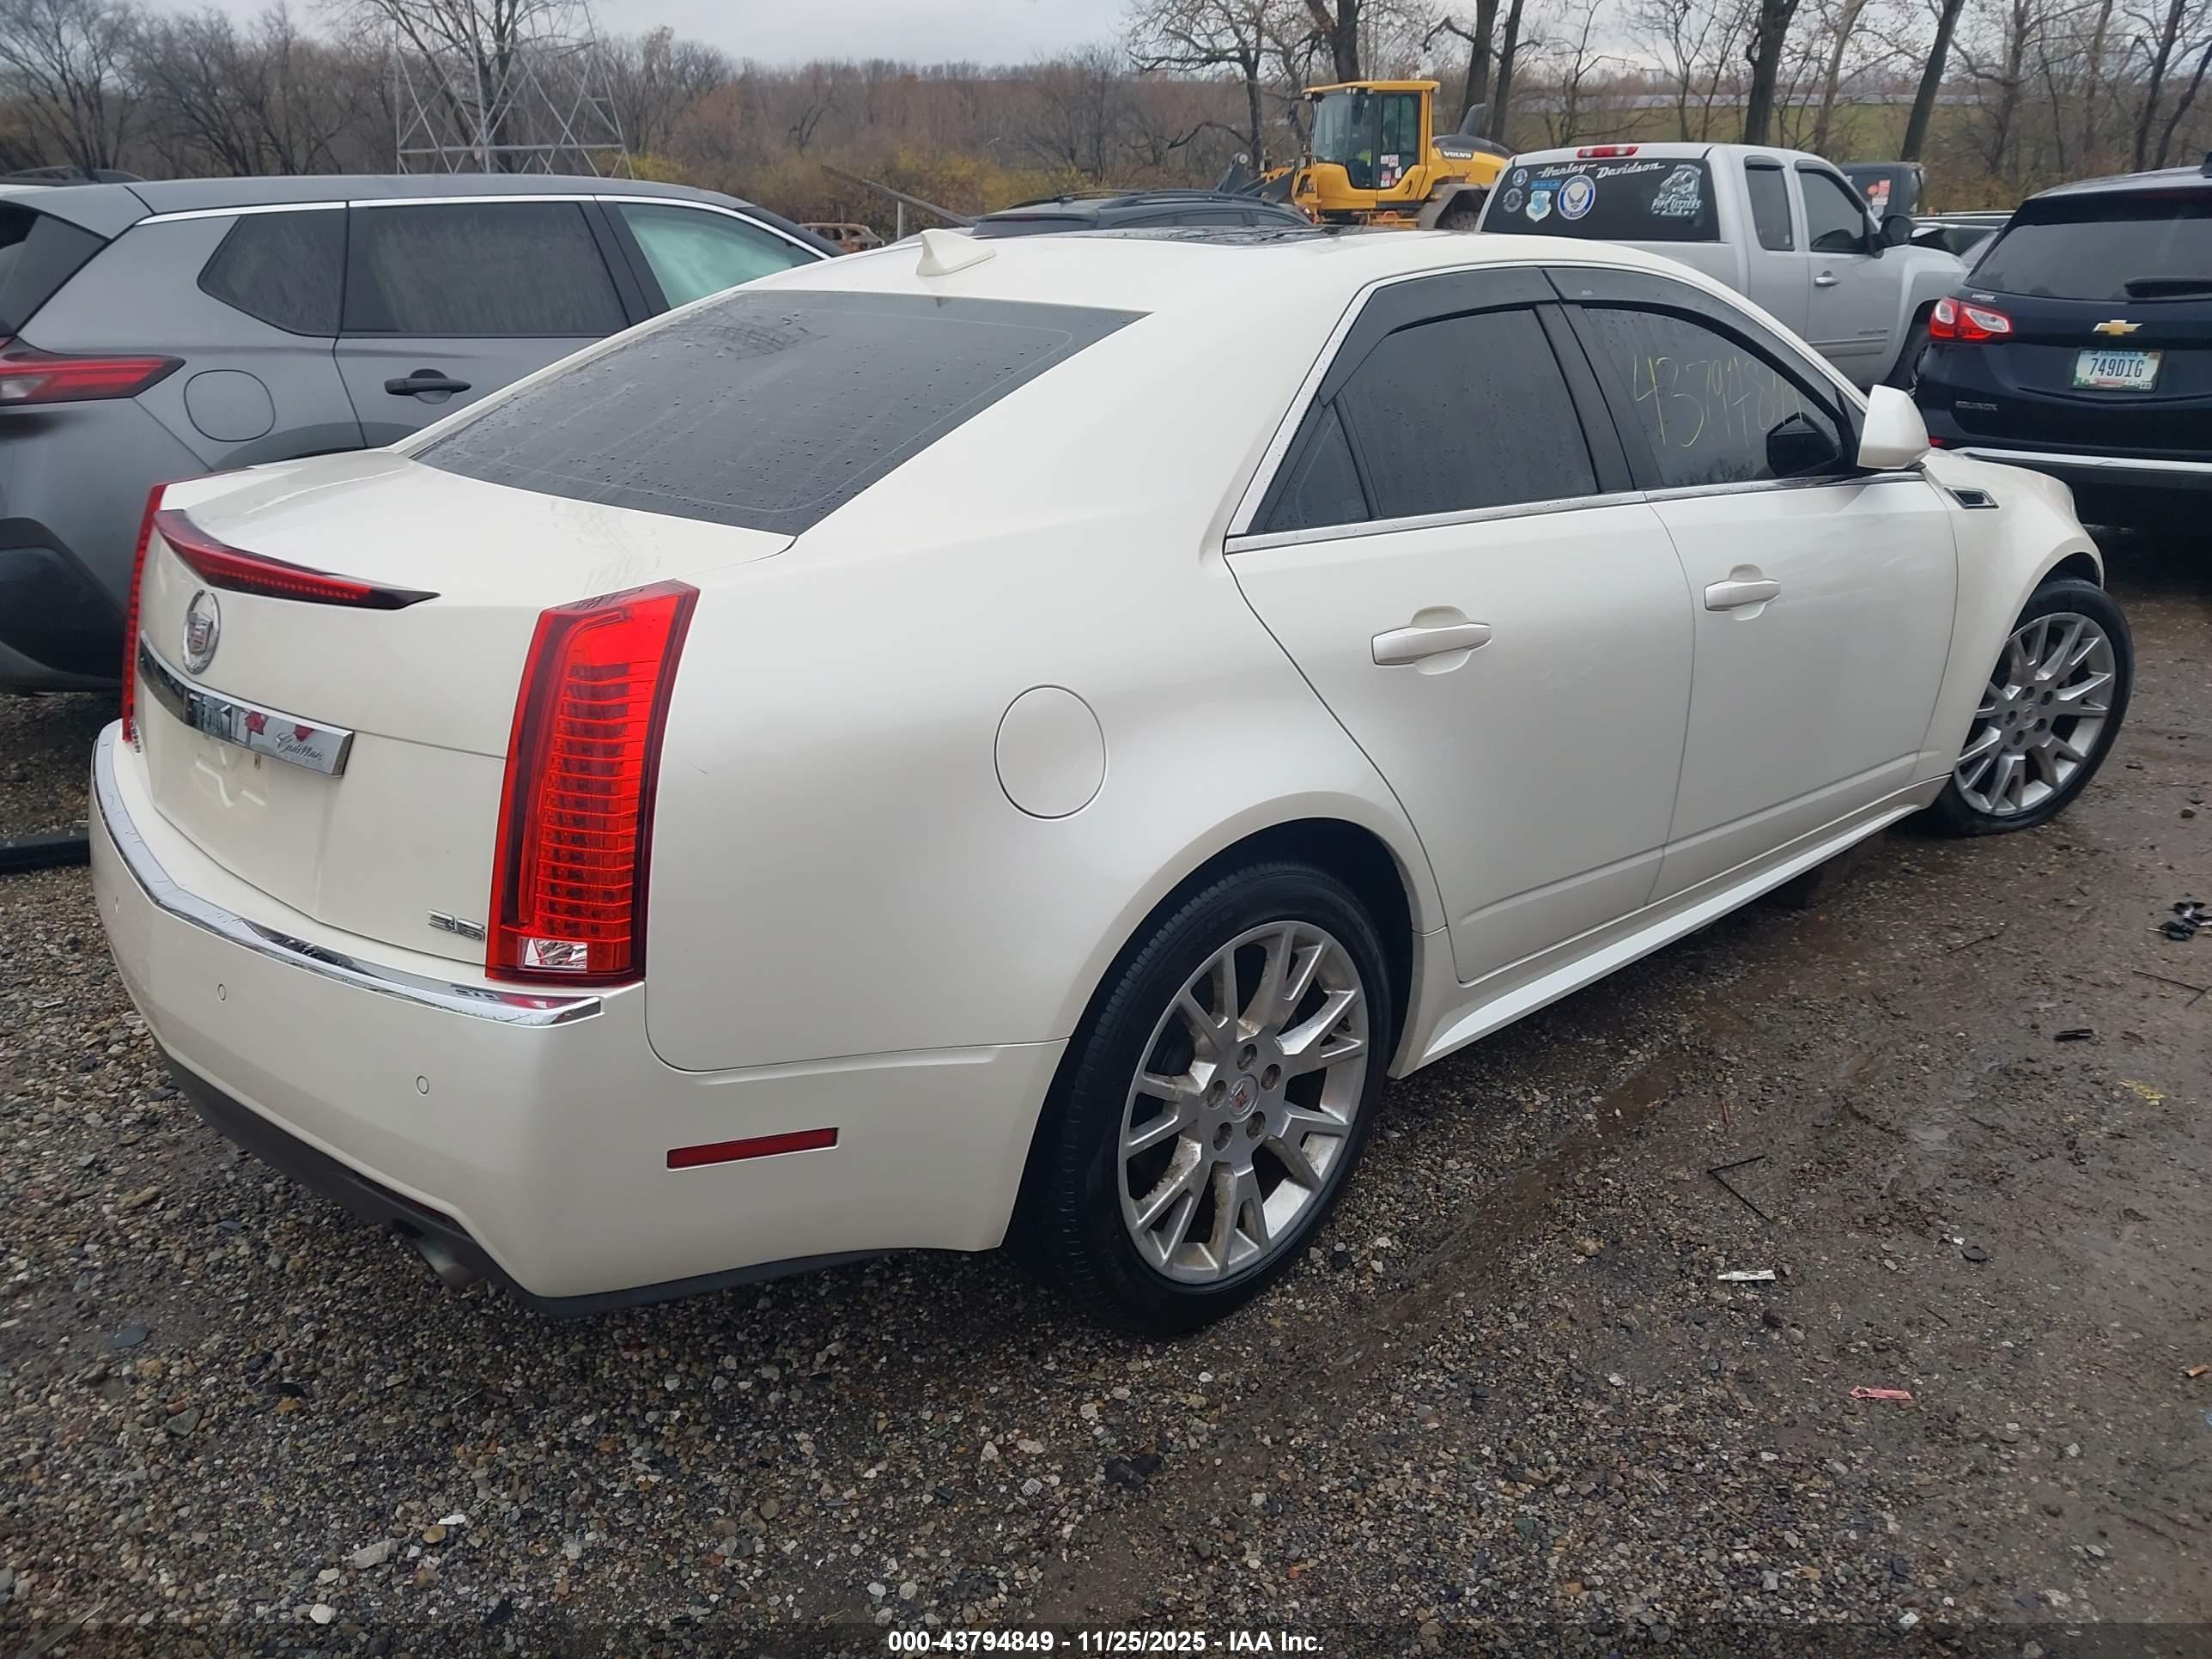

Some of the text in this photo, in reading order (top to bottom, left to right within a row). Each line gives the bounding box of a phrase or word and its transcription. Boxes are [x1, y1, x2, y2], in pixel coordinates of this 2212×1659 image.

[1443, 150, 1472, 159] VOLVO
[1595, 161, 1665, 179] Davidson
[2088, 357, 2145, 378] 749DIG
